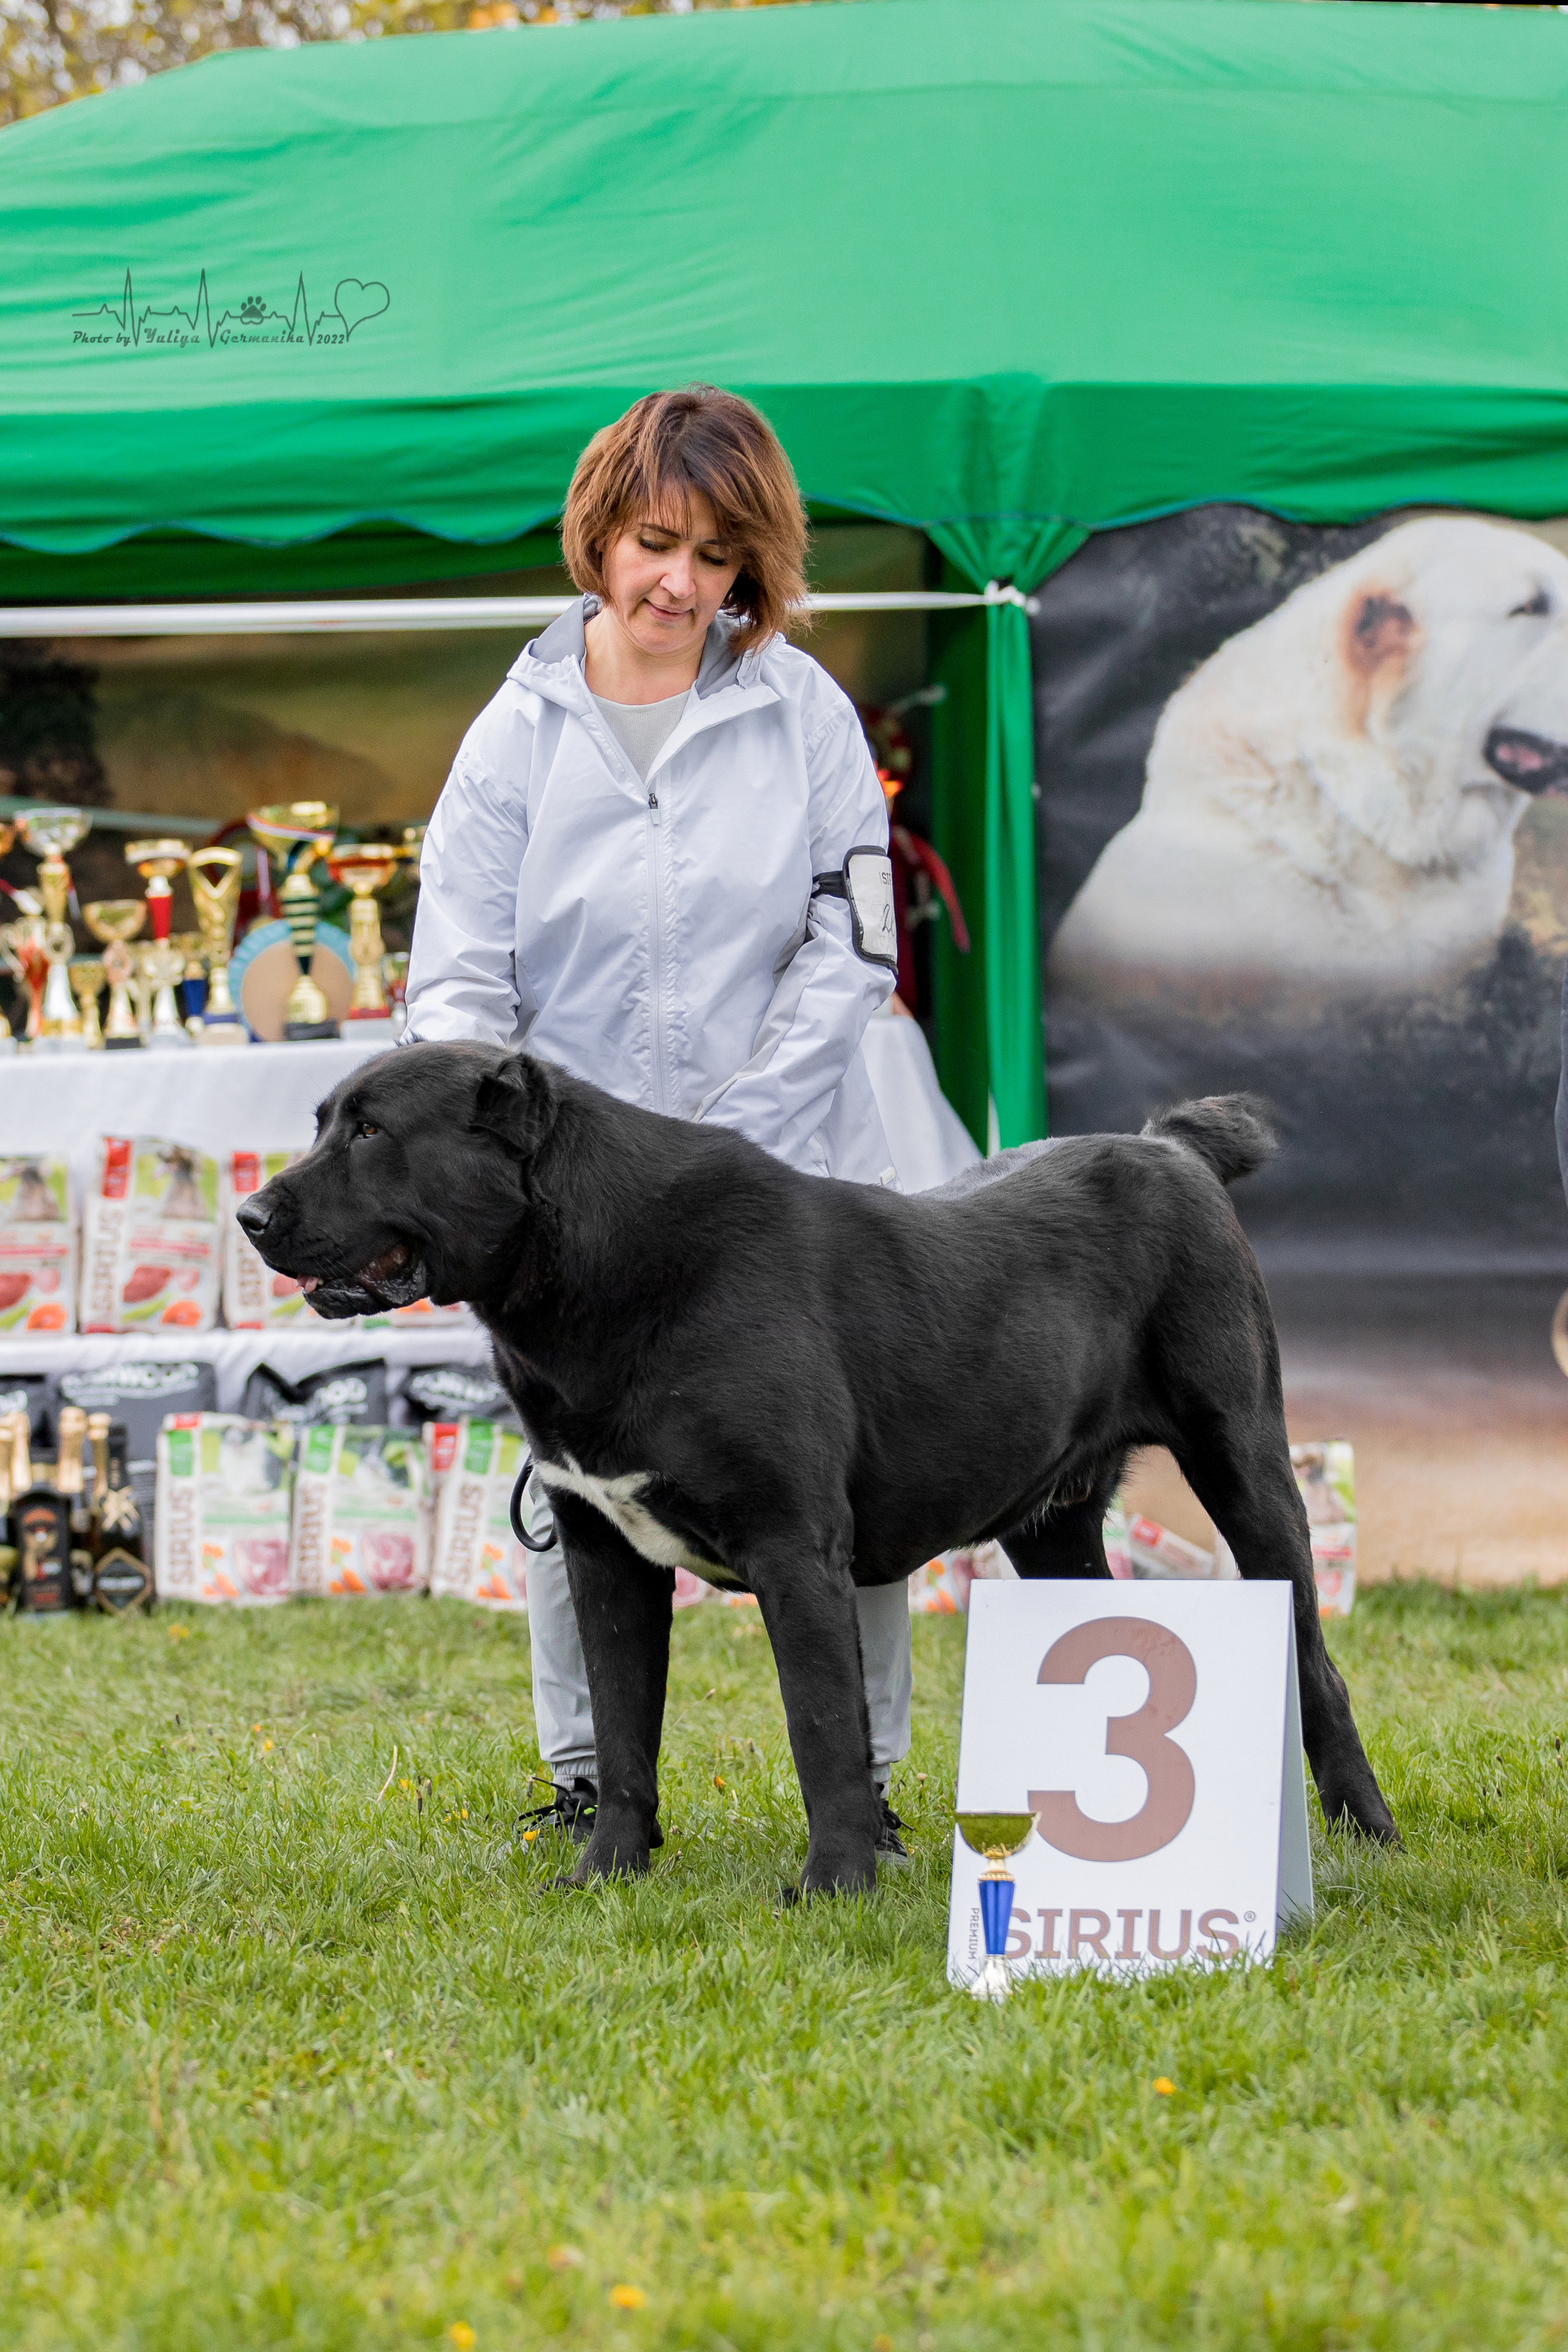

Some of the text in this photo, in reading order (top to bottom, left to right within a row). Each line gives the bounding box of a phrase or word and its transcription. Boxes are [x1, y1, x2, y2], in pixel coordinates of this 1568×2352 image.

[168, 1486, 195, 1585] SIRIUS
[298, 1482, 326, 1585] SIRIUS
[443, 1482, 485, 1586] SIRIUS
[1027, 1616, 1197, 1863] 3
[968, 1907, 980, 1959] PREMIUM
